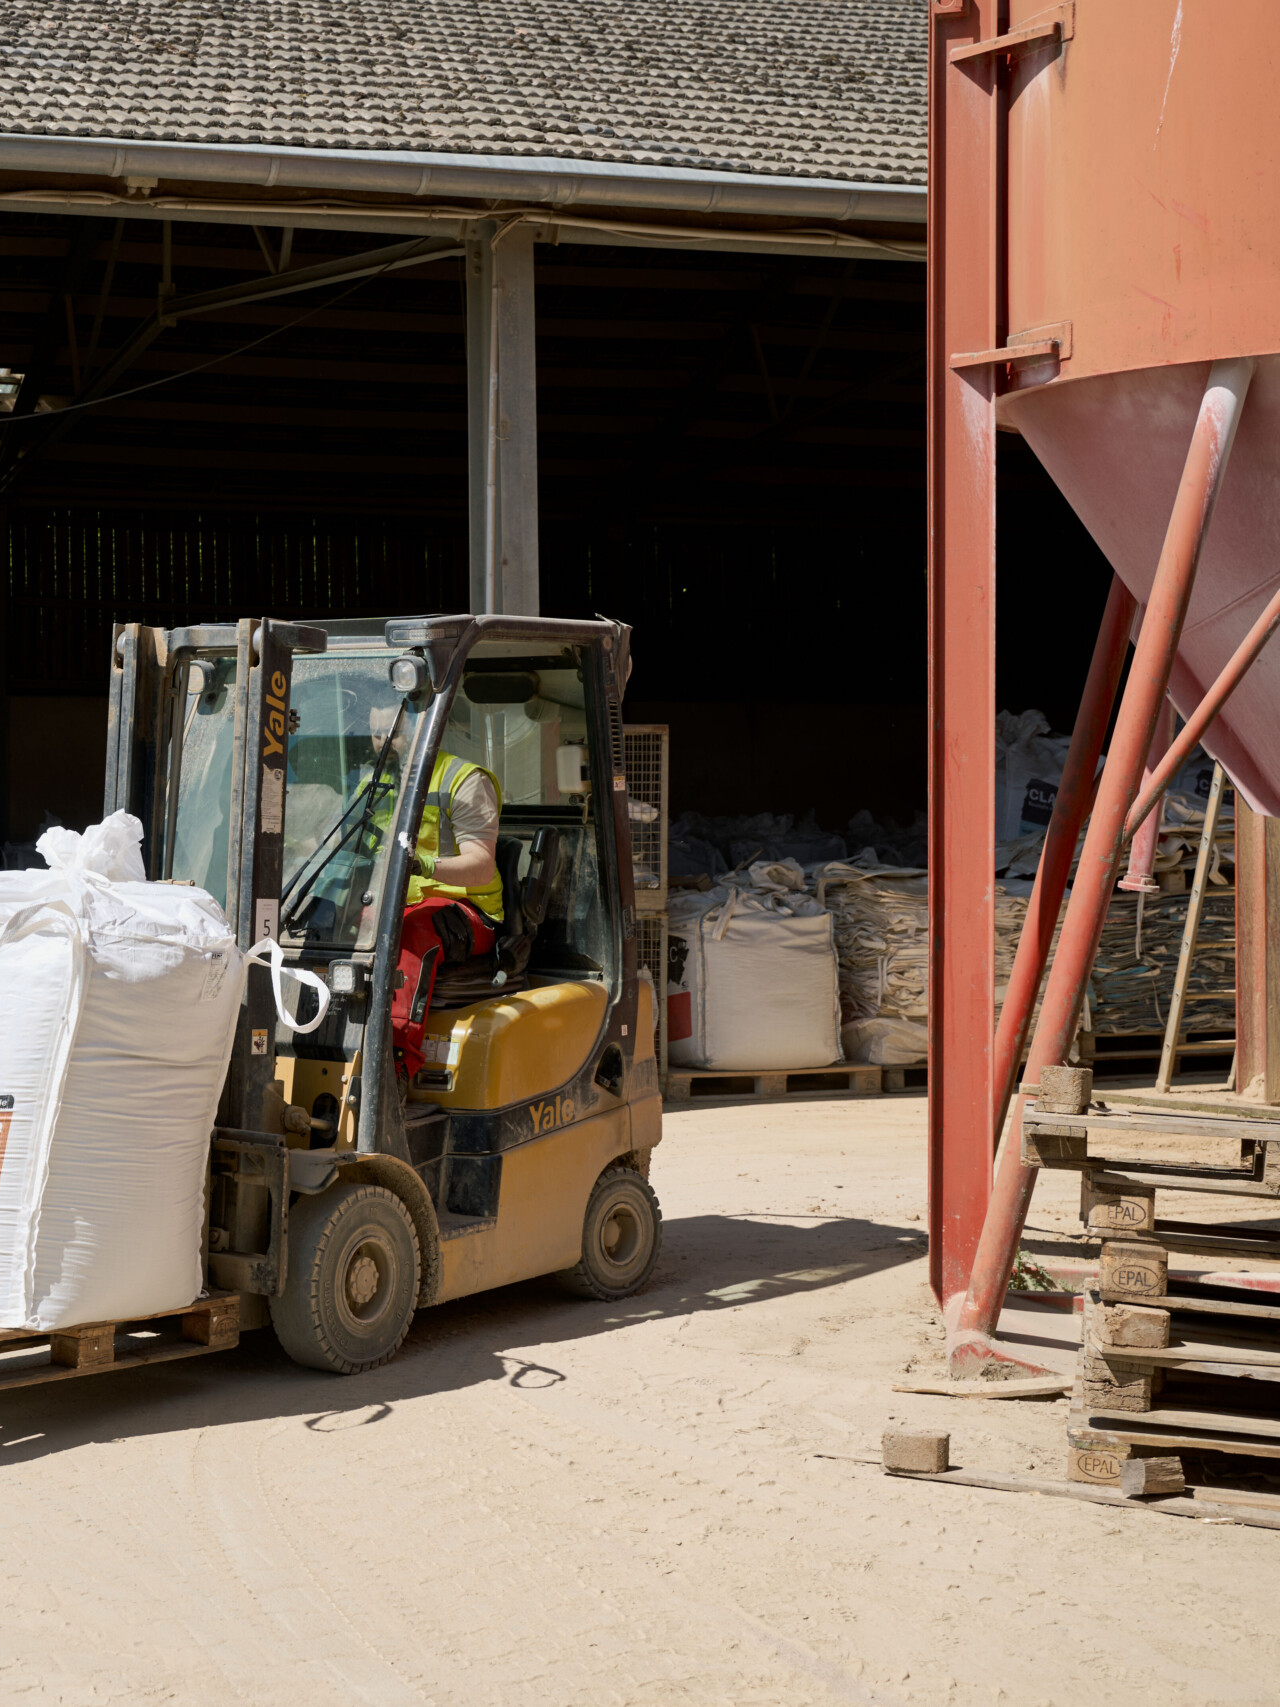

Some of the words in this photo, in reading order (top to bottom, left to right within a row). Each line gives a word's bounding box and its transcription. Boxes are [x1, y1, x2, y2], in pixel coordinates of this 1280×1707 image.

[263, 670, 286, 757] Yale
[263, 919, 271, 937] 5
[529, 1096, 575, 1134] Yale
[1108, 1205, 1139, 1221] EPAL
[1118, 1270, 1152, 1287] EPAL
[1084, 1457, 1117, 1475] EPAL
